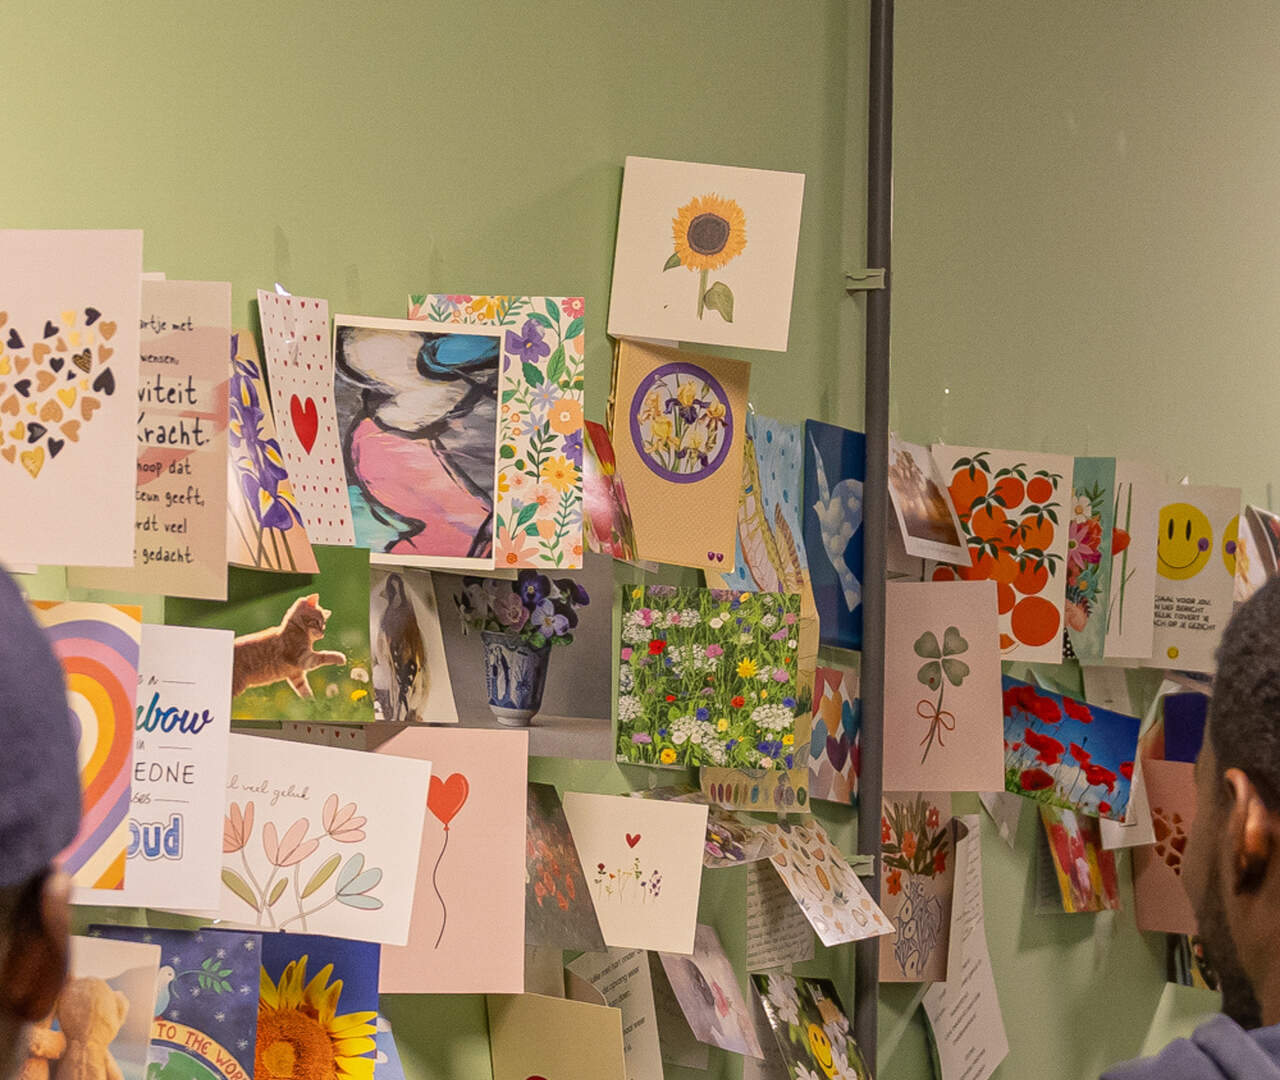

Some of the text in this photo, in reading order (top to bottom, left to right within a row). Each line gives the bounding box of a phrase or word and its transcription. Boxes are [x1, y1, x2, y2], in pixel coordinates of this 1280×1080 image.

[172, 316, 194, 331] met
[138, 373, 197, 405] viteit
[169, 457, 192, 475] dat
[164, 518, 187, 534] veel
[142, 546, 195, 564] gedacht
[242, 780, 269, 794] veel
[270, 784, 311, 807] geluk
[157, 1023, 177, 1040] TO
[184, 1031, 213, 1055] THE
